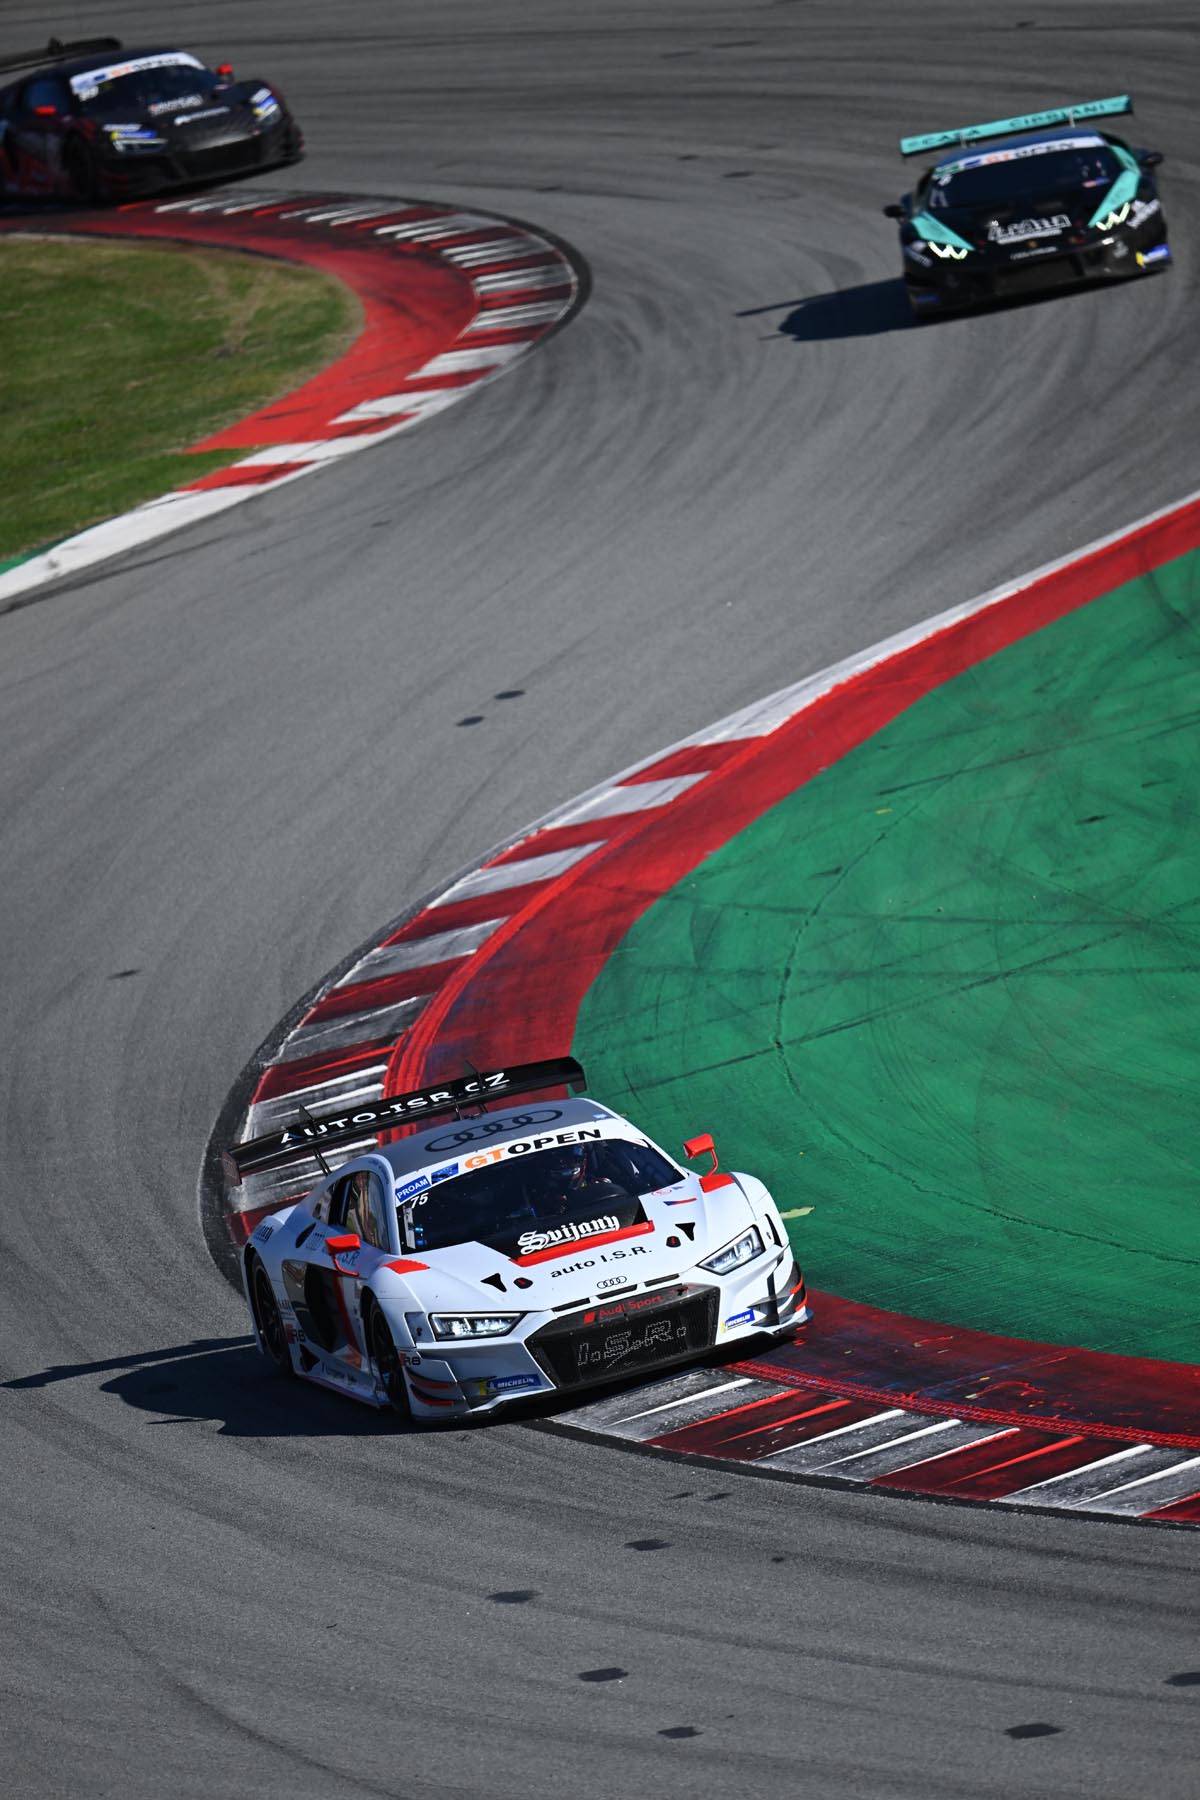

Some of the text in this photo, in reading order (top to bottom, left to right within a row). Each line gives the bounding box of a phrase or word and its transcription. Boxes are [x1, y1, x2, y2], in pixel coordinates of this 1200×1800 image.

[396, 1178, 429, 1199] PROAM
[410, 1192, 429, 1209] 75
[517, 1215, 620, 1255] Svijany
[551, 1246, 653, 1278] auto I.S.R.
[599, 1295, 663, 1318] Audi Sport
[497, 1376, 535, 1388] MICHELIN
